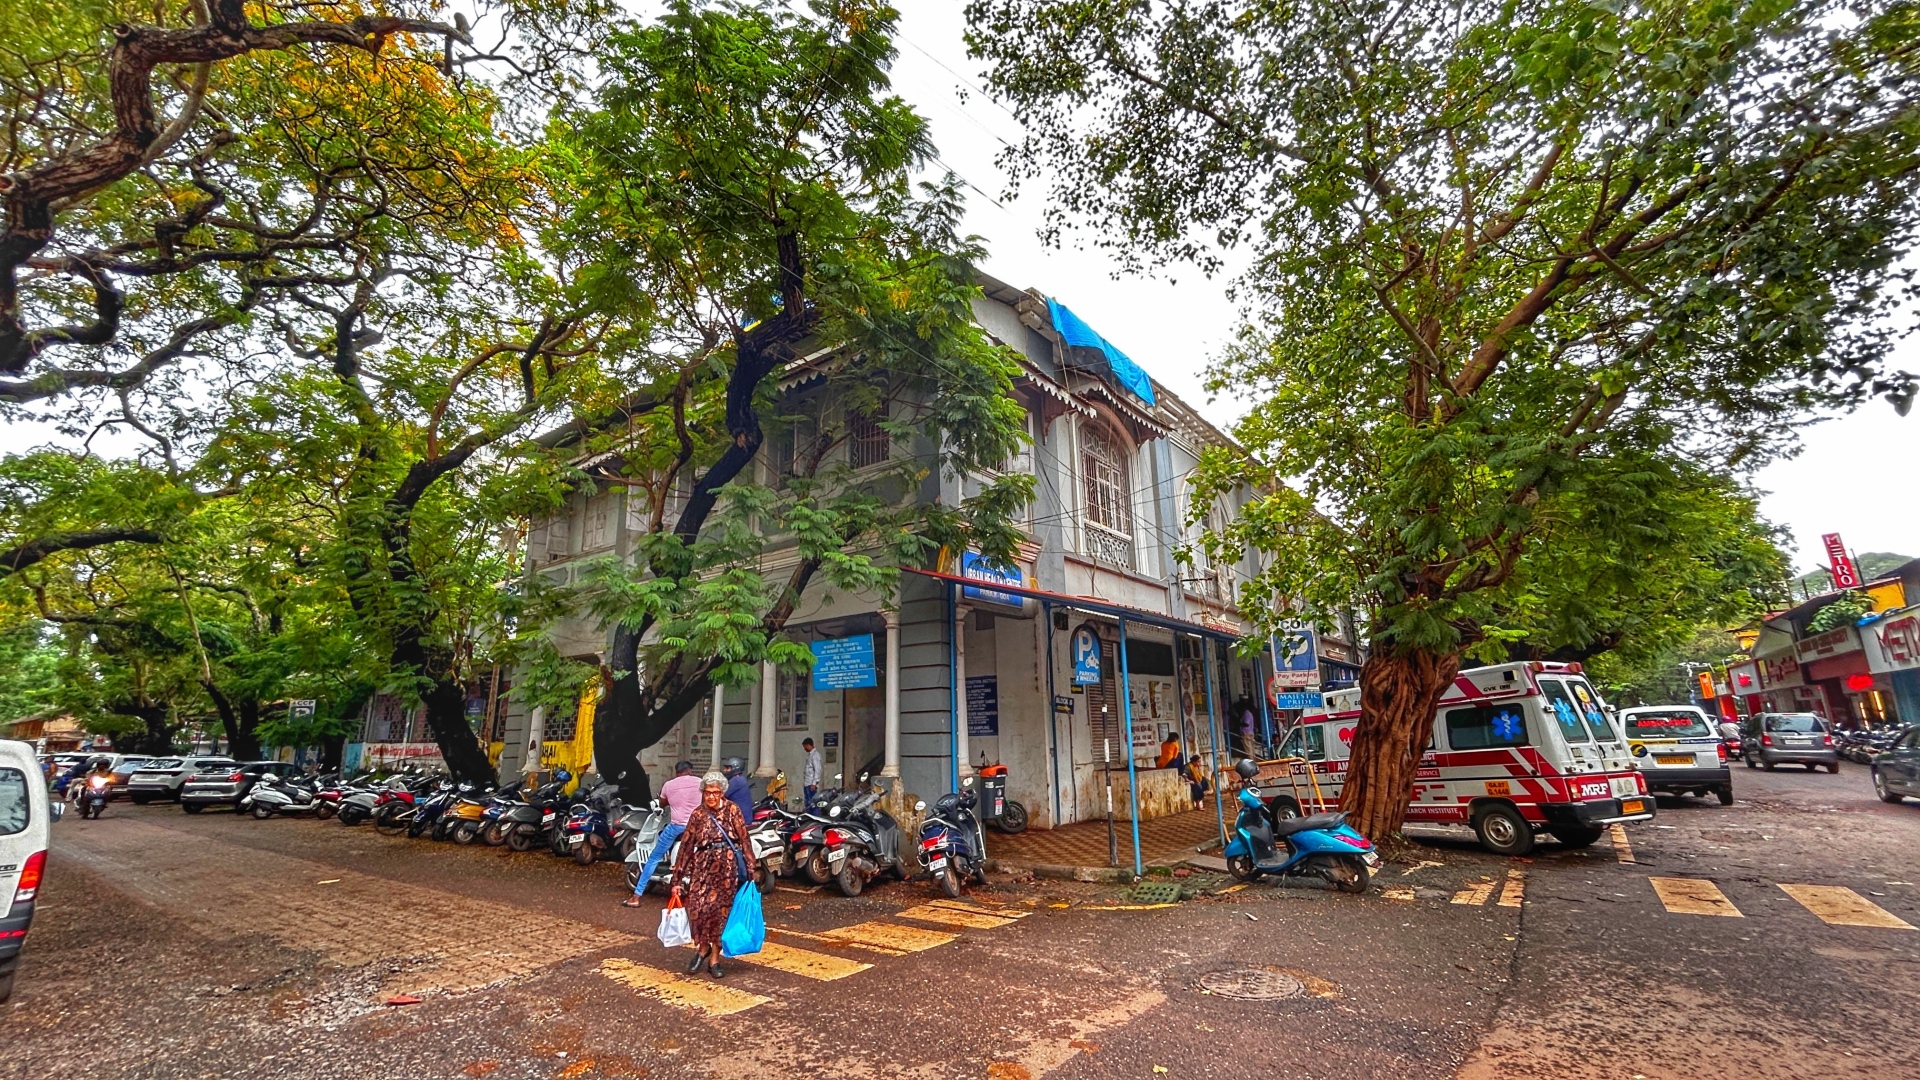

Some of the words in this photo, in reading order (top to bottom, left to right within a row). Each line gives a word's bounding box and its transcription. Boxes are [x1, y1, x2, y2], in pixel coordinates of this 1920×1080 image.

[1825, 534, 1853, 586] METRO
[965, 567, 984, 581] URBAN
[1078, 630, 1093, 662] P
[1281, 634, 1309, 668] P
[1078, 670, 1098, 679] PARKING
[1079, 675, 1100, 683] WHEELER
[1276, 673, 1290, 681] Pay
[1291, 672, 1318, 680] Parking
[1055, 696, 1069, 705] BLOCK
[1279, 692, 1320, 701] MAJESTIC
[1287, 698, 1313, 706] PRIDE
[1636, 717, 1694, 728] AMBULANCE
[1581, 783, 1608, 796] MRF
[1427, 807, 1459, 815] INSTITUTE
